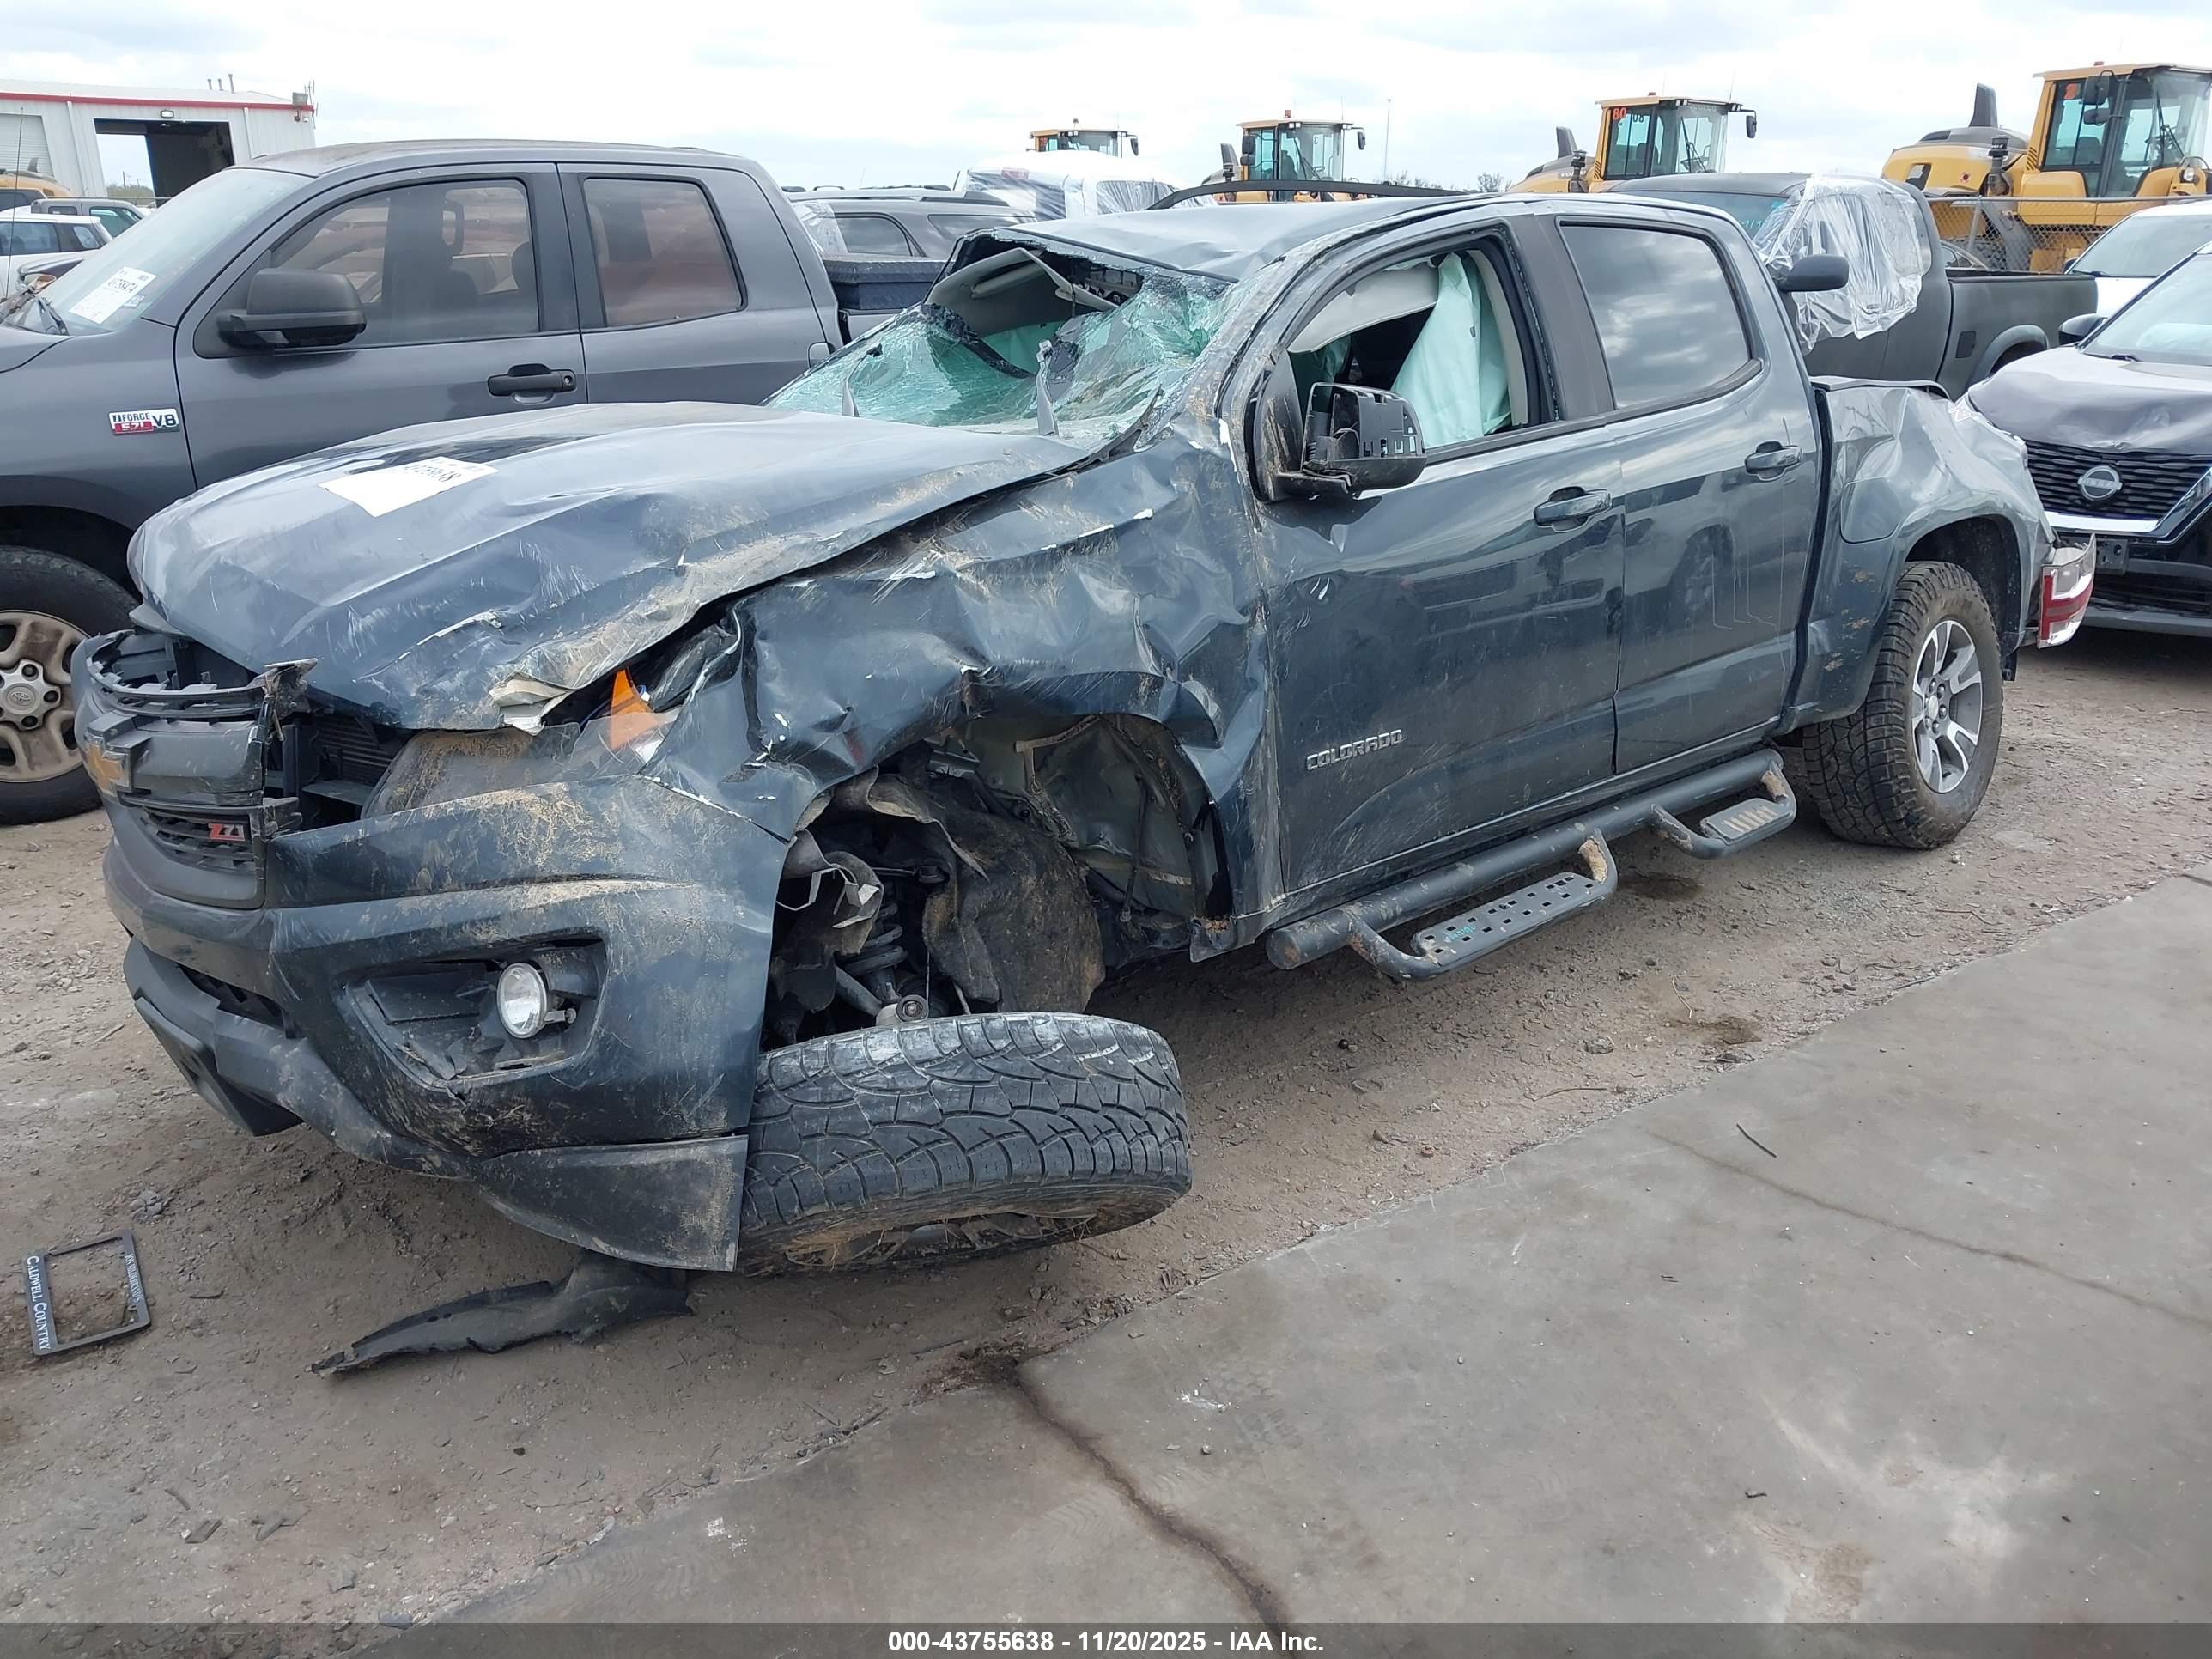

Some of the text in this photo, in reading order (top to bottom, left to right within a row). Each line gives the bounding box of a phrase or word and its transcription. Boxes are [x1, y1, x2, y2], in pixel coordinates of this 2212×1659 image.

[1613, 107, 1626, 120] 80
[153, 415, 177, 427] V8
[1307, 729, 1403, 771] COLORADO
[208, 823, 246, 841] Z71
[27, 1255, 51, 1350] CALDWELL COUNTRY
